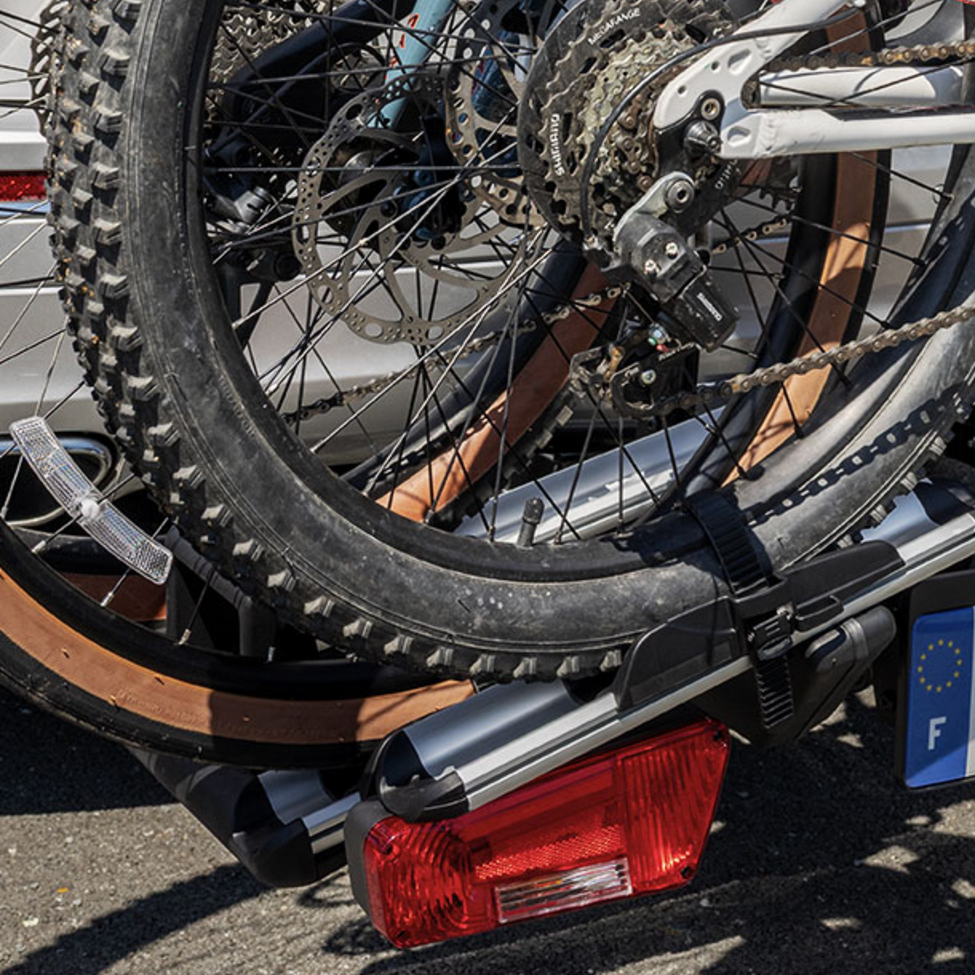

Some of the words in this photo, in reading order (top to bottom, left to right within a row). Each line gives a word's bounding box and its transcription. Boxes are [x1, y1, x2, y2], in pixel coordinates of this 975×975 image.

[587, 7, 640, 45] MEGARANGE
[549, 112, 566, 176] SHIMANO
[927, 717, 947, 750] F
